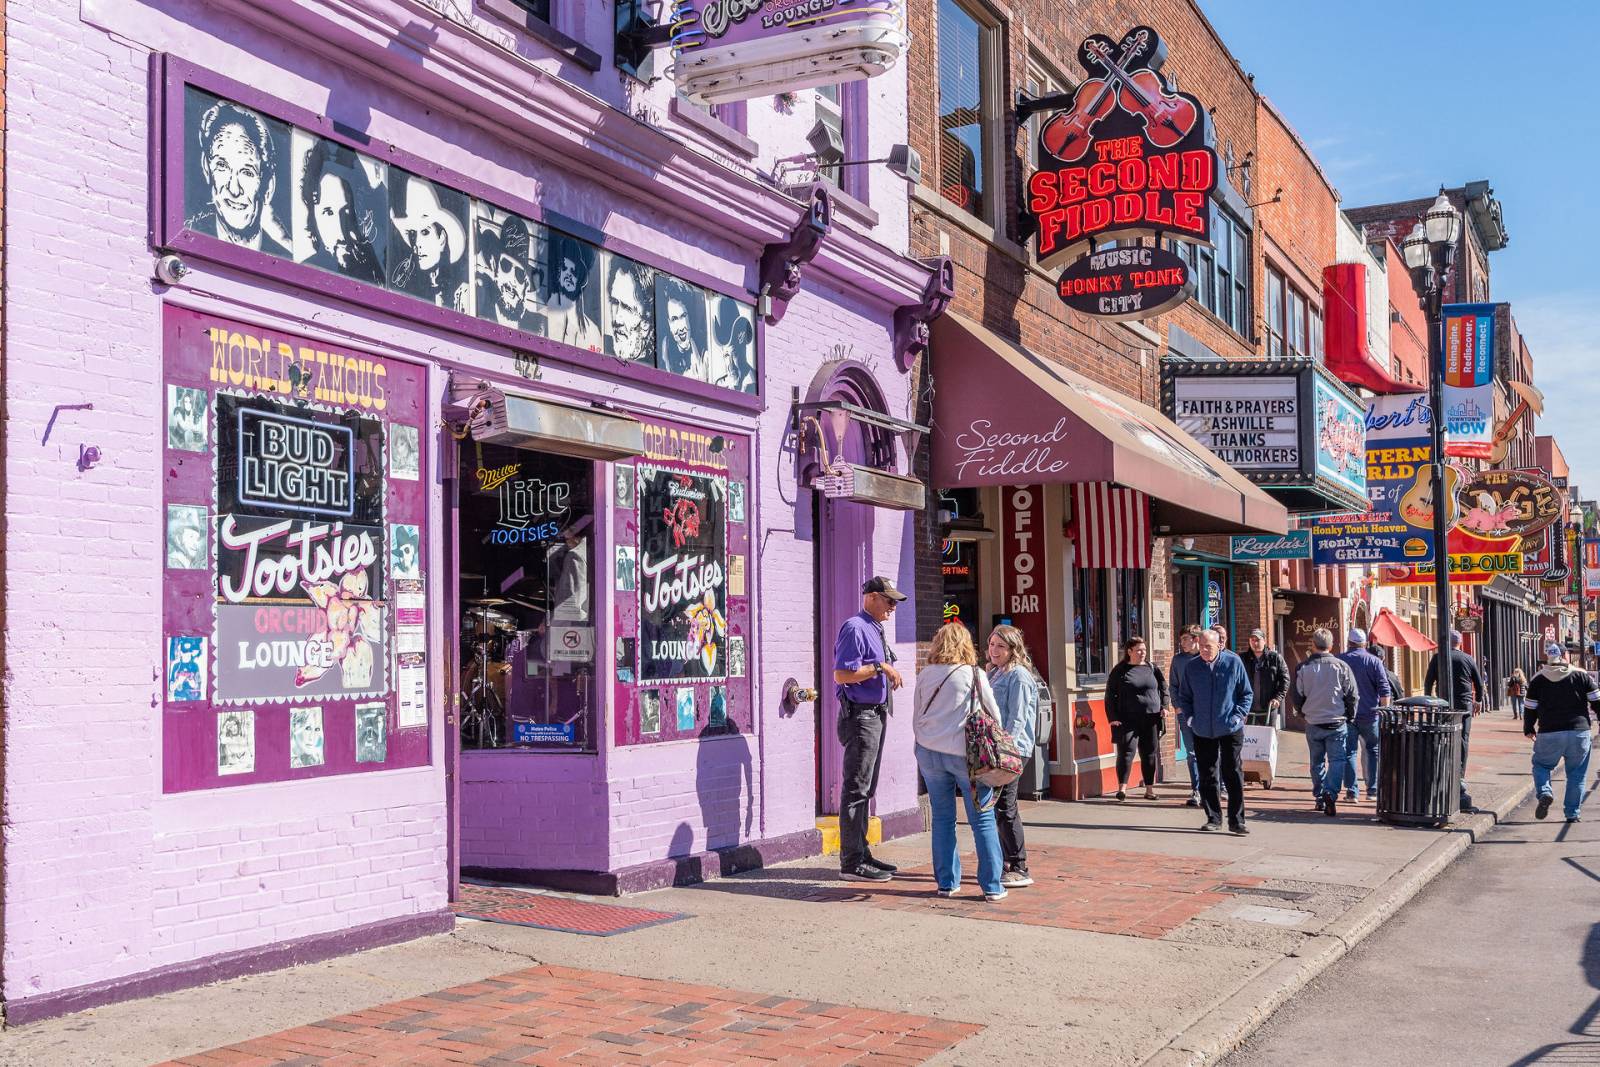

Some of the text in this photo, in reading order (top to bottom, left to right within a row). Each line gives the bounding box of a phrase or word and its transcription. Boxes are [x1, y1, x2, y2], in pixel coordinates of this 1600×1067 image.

[1095, 136, 1143, 161] THE
[1030, 151, 1213, 213] SECOND
[1039, 192, 1204, 254] FIDDLE
[1091, 249, 1152, 271] MUSIC
[1060, 267, 1185, 297] HONKY TONK
[1099, 292, 1143, 313] CITY
[1449, 323, 1459, 373] Reimagine.
[1463, 320, 1473, 373] Rediscover.
[1477, 321, 1487, 373] Reconnect.
[210, 328, 387, 410] WORLD FAMOUS
[1182, 400, 1294, 414] FAITH & PRAYERS
[1366, 396, 1431, 431] bert's
[956, 417, 1068, 450] Second
[1211, 416, 1274, 430] ASHVILLE
[1448, 422, 1486, 434] NOW
[260, 420, 334, 467] BUD
[1211, 433, 1266, 447] THANKS
[954, 448, 1069, 480] Fiddle
[1366, 447, 1431, 464] TERN
[476, 463, 522, 486] Miller
[1367, 464, 1415, 480] RLD
[1484, 474, 1508, 485] THE
[496, 478, 570, 529] Lite
[1388, 484, 1403, 504] of
[491, 521, 559, 544] TOOTSIES
[1012, 484, 1035, 594] OFTOP
[1312, 524, 1407, 536] Honky Tonk Heaven
[1318, 535, 1400, 549] Honky Tonk
[220, 513, 377, 602] Tootsies
[1335, 548, 1383, 560] GRILL
[642, 551, 723, 611] Tootsies
[1011, 595, 1039, 613] BAR
[254, 607, 328, 634] ORCHID
[238, 641, 333, 669] LOUNGE
[652, 640, 701, 660] LOUNGE
